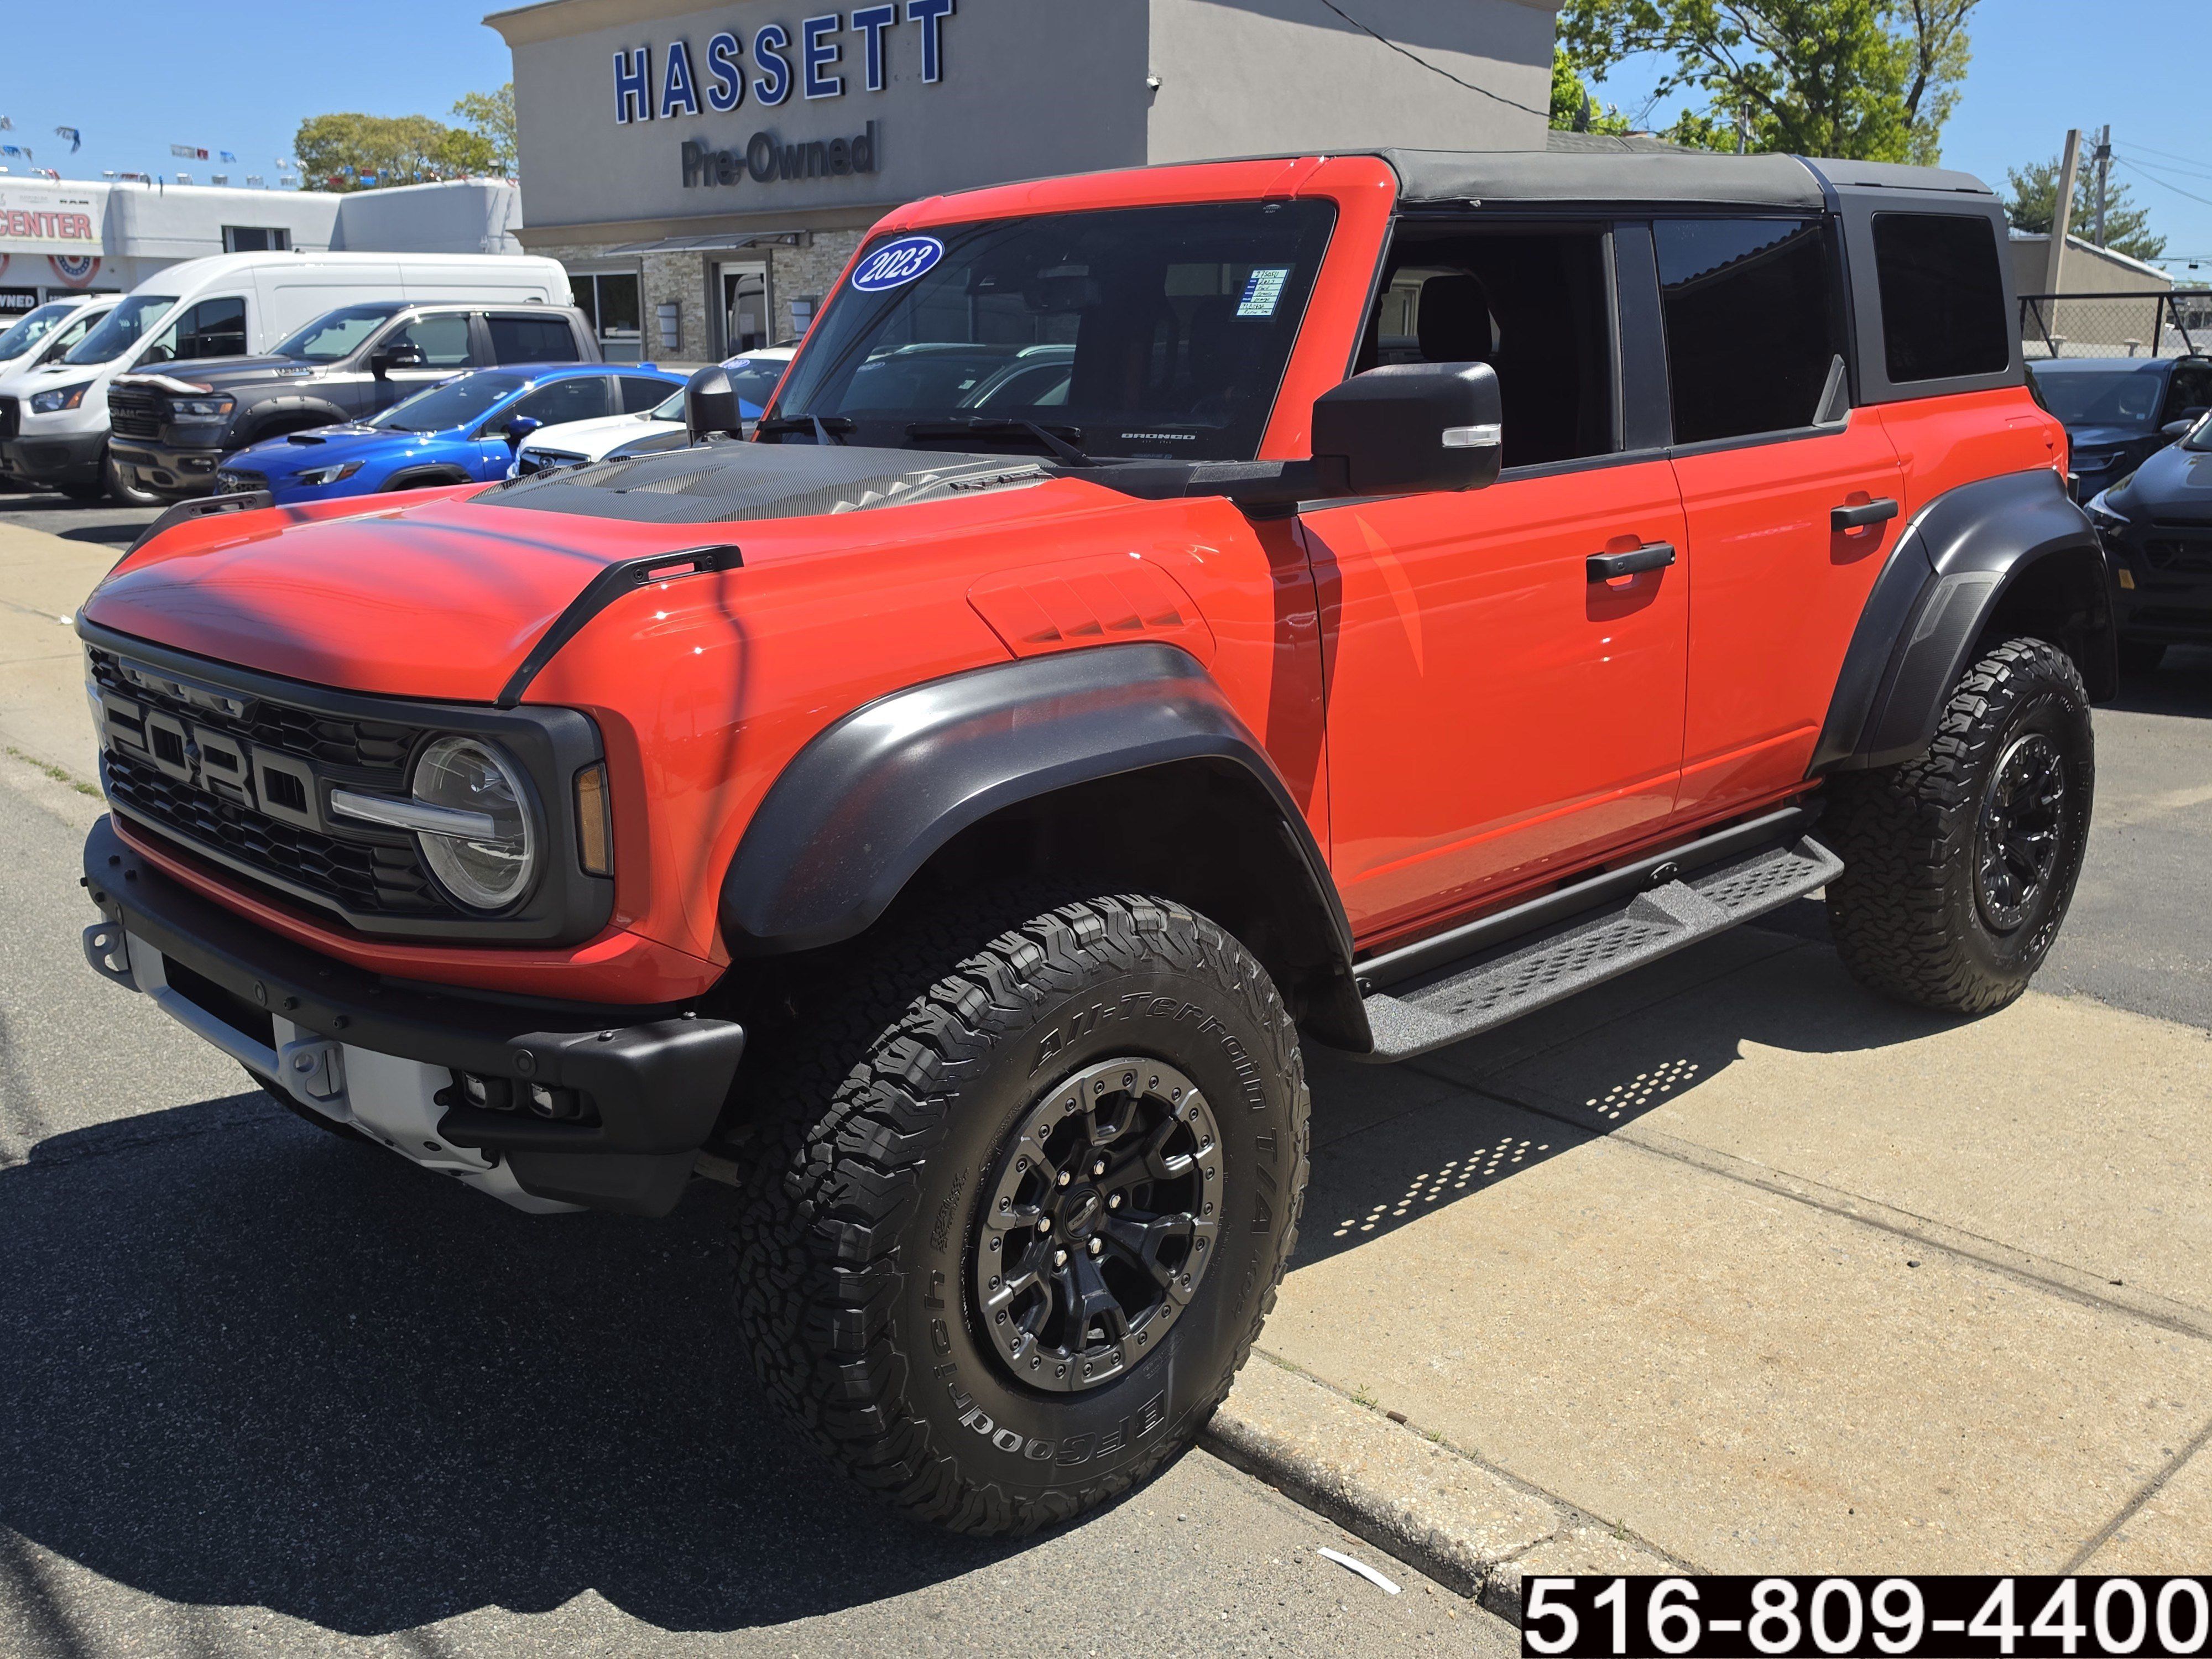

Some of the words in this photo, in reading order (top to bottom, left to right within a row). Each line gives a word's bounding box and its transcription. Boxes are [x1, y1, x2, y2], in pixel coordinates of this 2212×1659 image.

[613, 0, 954, 124] HASSETT
[681, 120, 877, 189] Pre-Owned
[858, 245, 933, 284] 2023
[103, 691, 323, 833] FORD
[1028, 992, 1267, 1110] All-Terrain
[924, 1268, 1165, 1467] BFGoodrich
